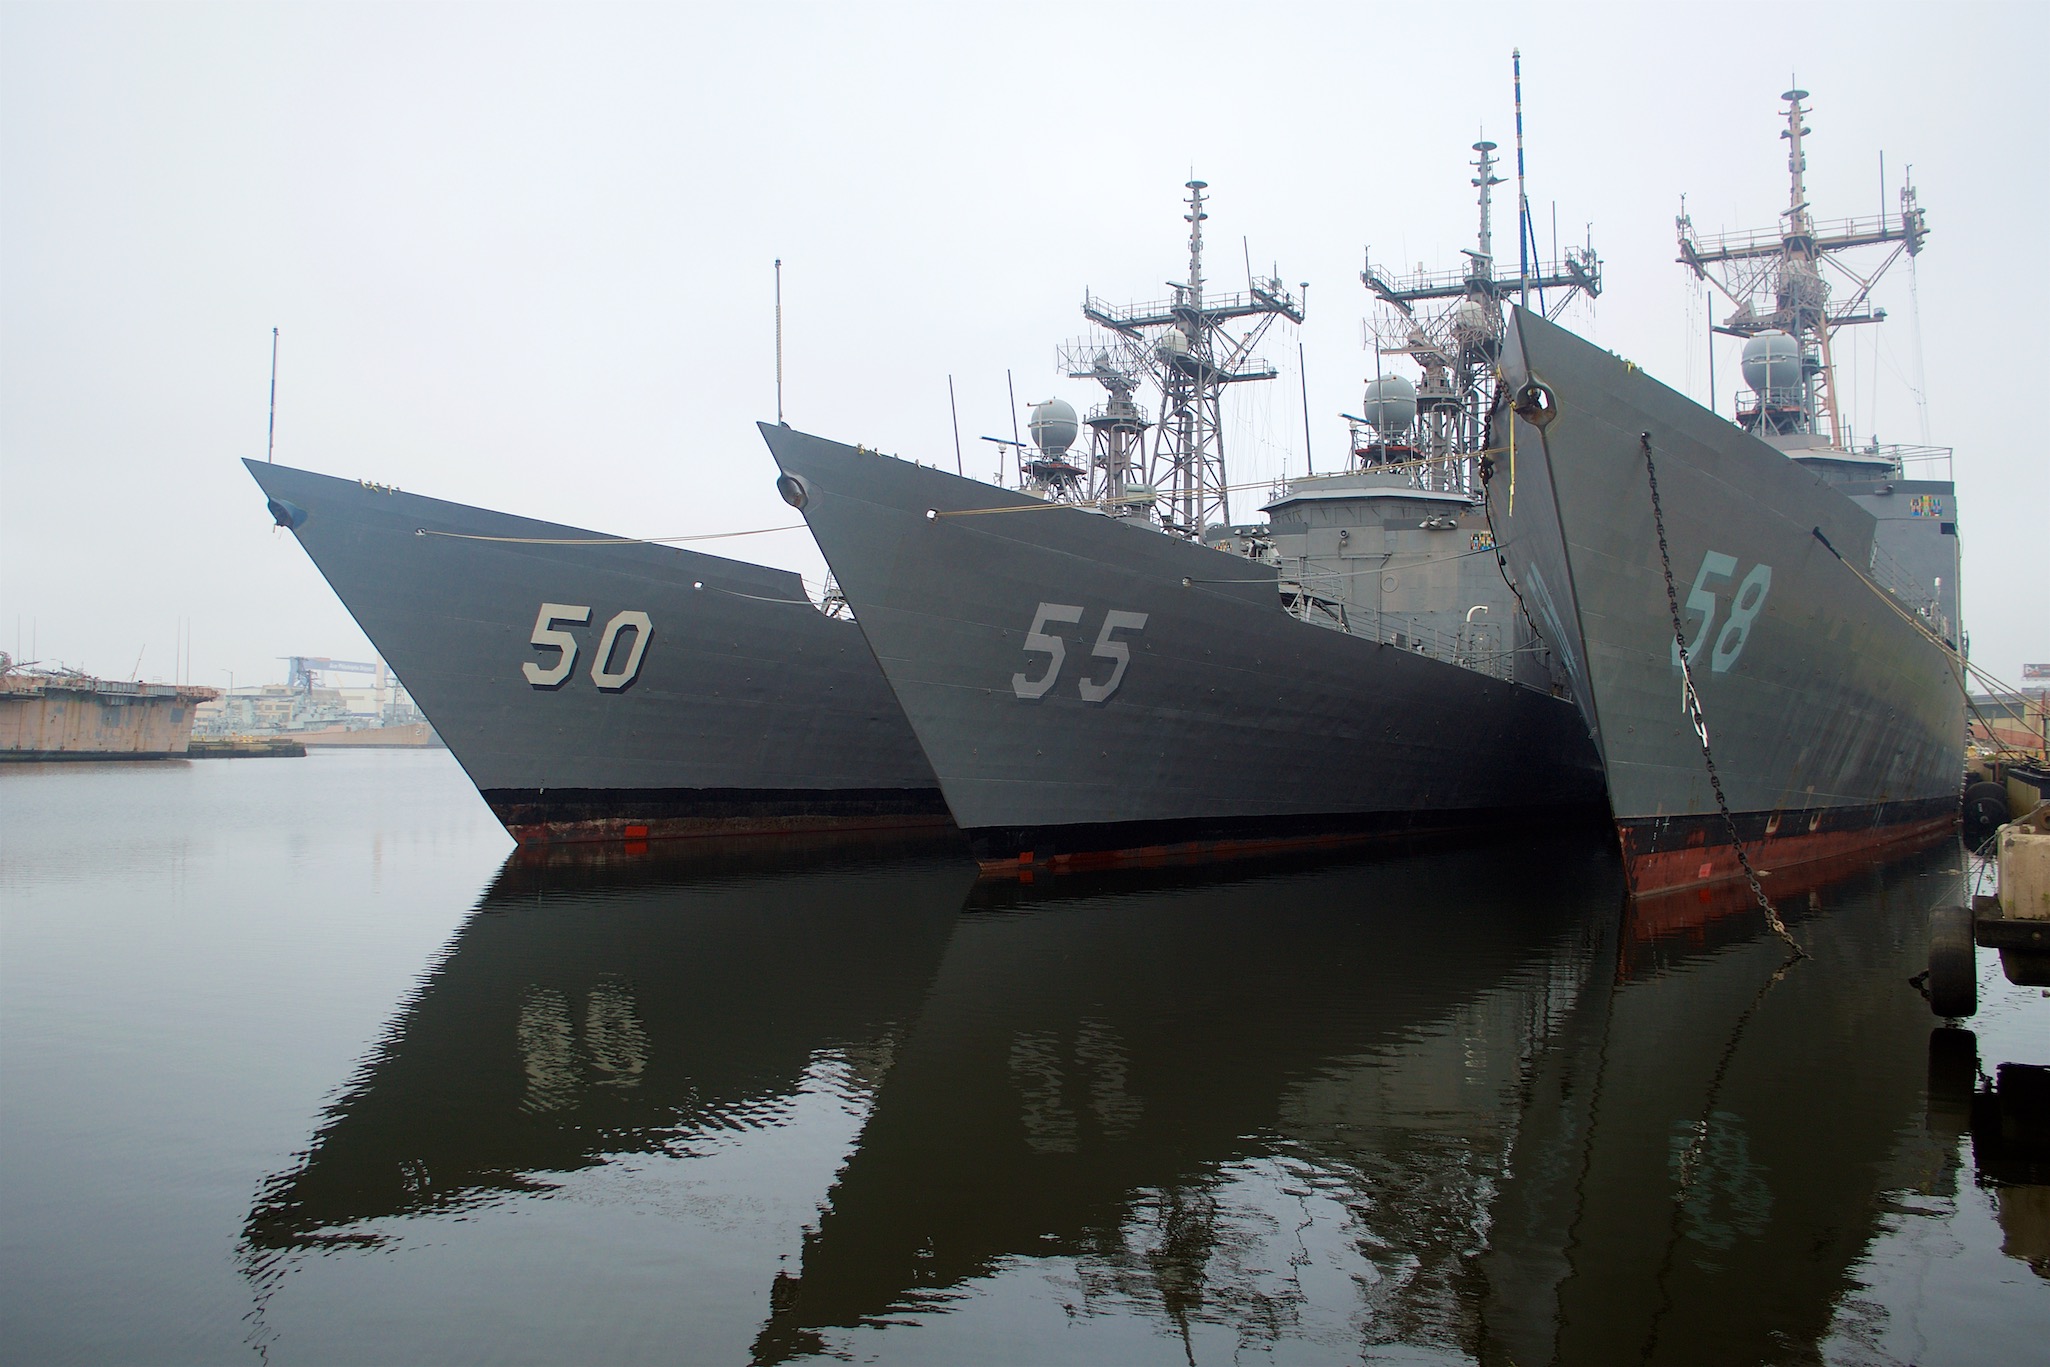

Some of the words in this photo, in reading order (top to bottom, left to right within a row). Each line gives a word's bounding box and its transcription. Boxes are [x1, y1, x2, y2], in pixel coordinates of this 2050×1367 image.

[522, 603, 654, 693] 50
[1012, 602, 1149, 702] 55
[1671, 550, 1772, 673] 58
